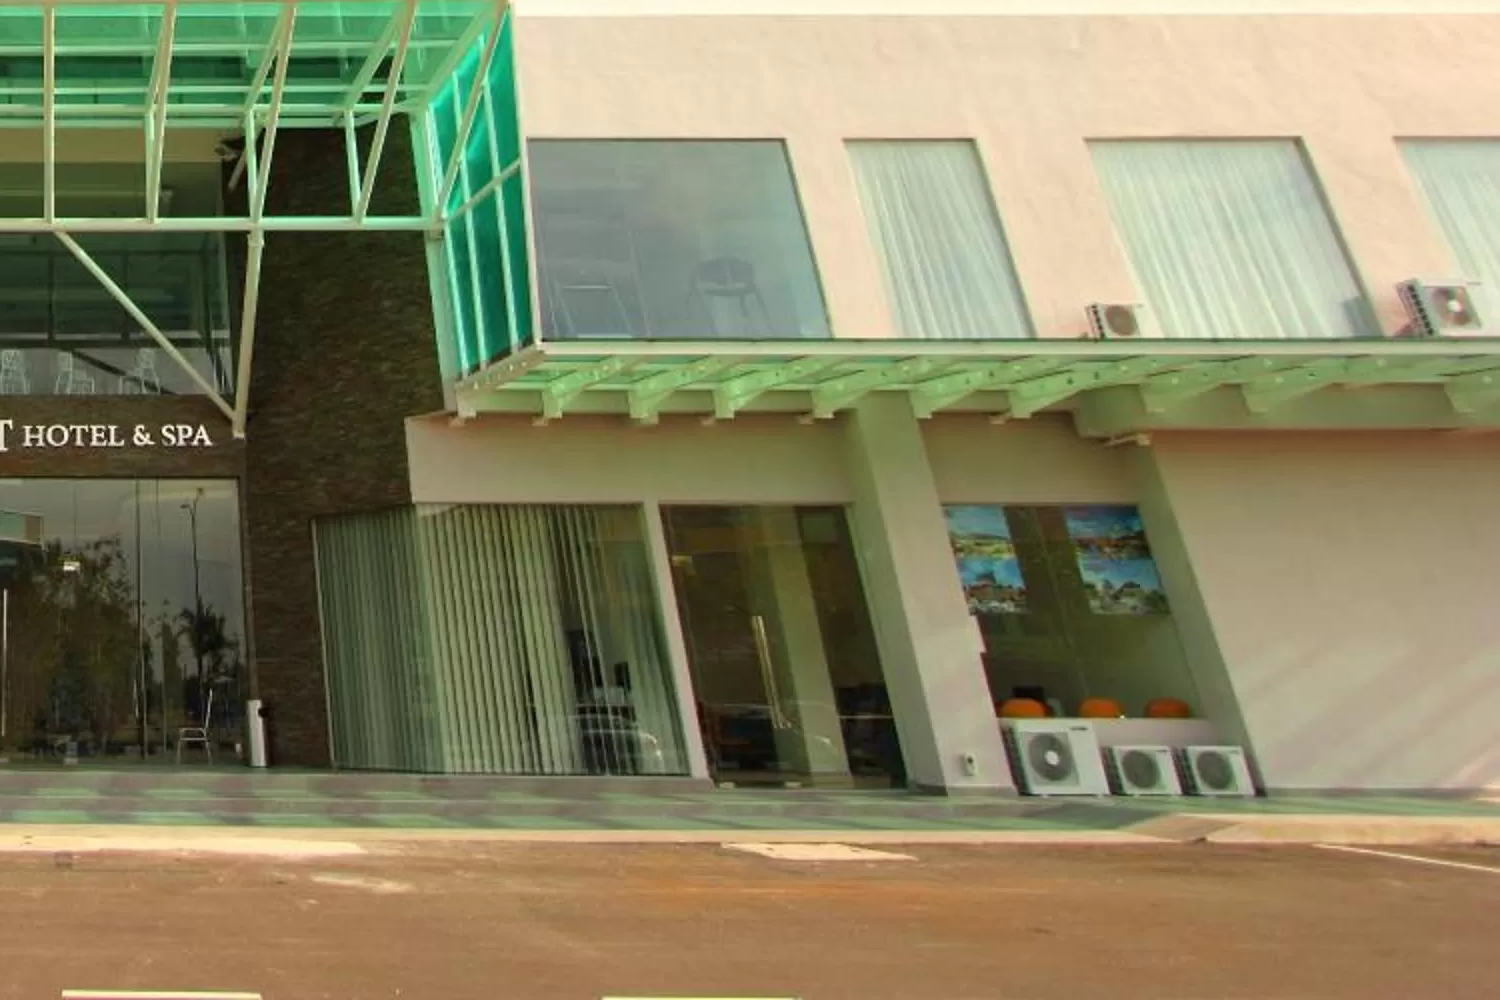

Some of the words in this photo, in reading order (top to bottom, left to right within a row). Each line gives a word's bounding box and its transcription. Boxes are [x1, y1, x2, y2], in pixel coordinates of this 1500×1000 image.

[22, 424, 125, 448] HOTEL
[132, 423, 156, 446] &
[160, 424, 213, 448] SPA
